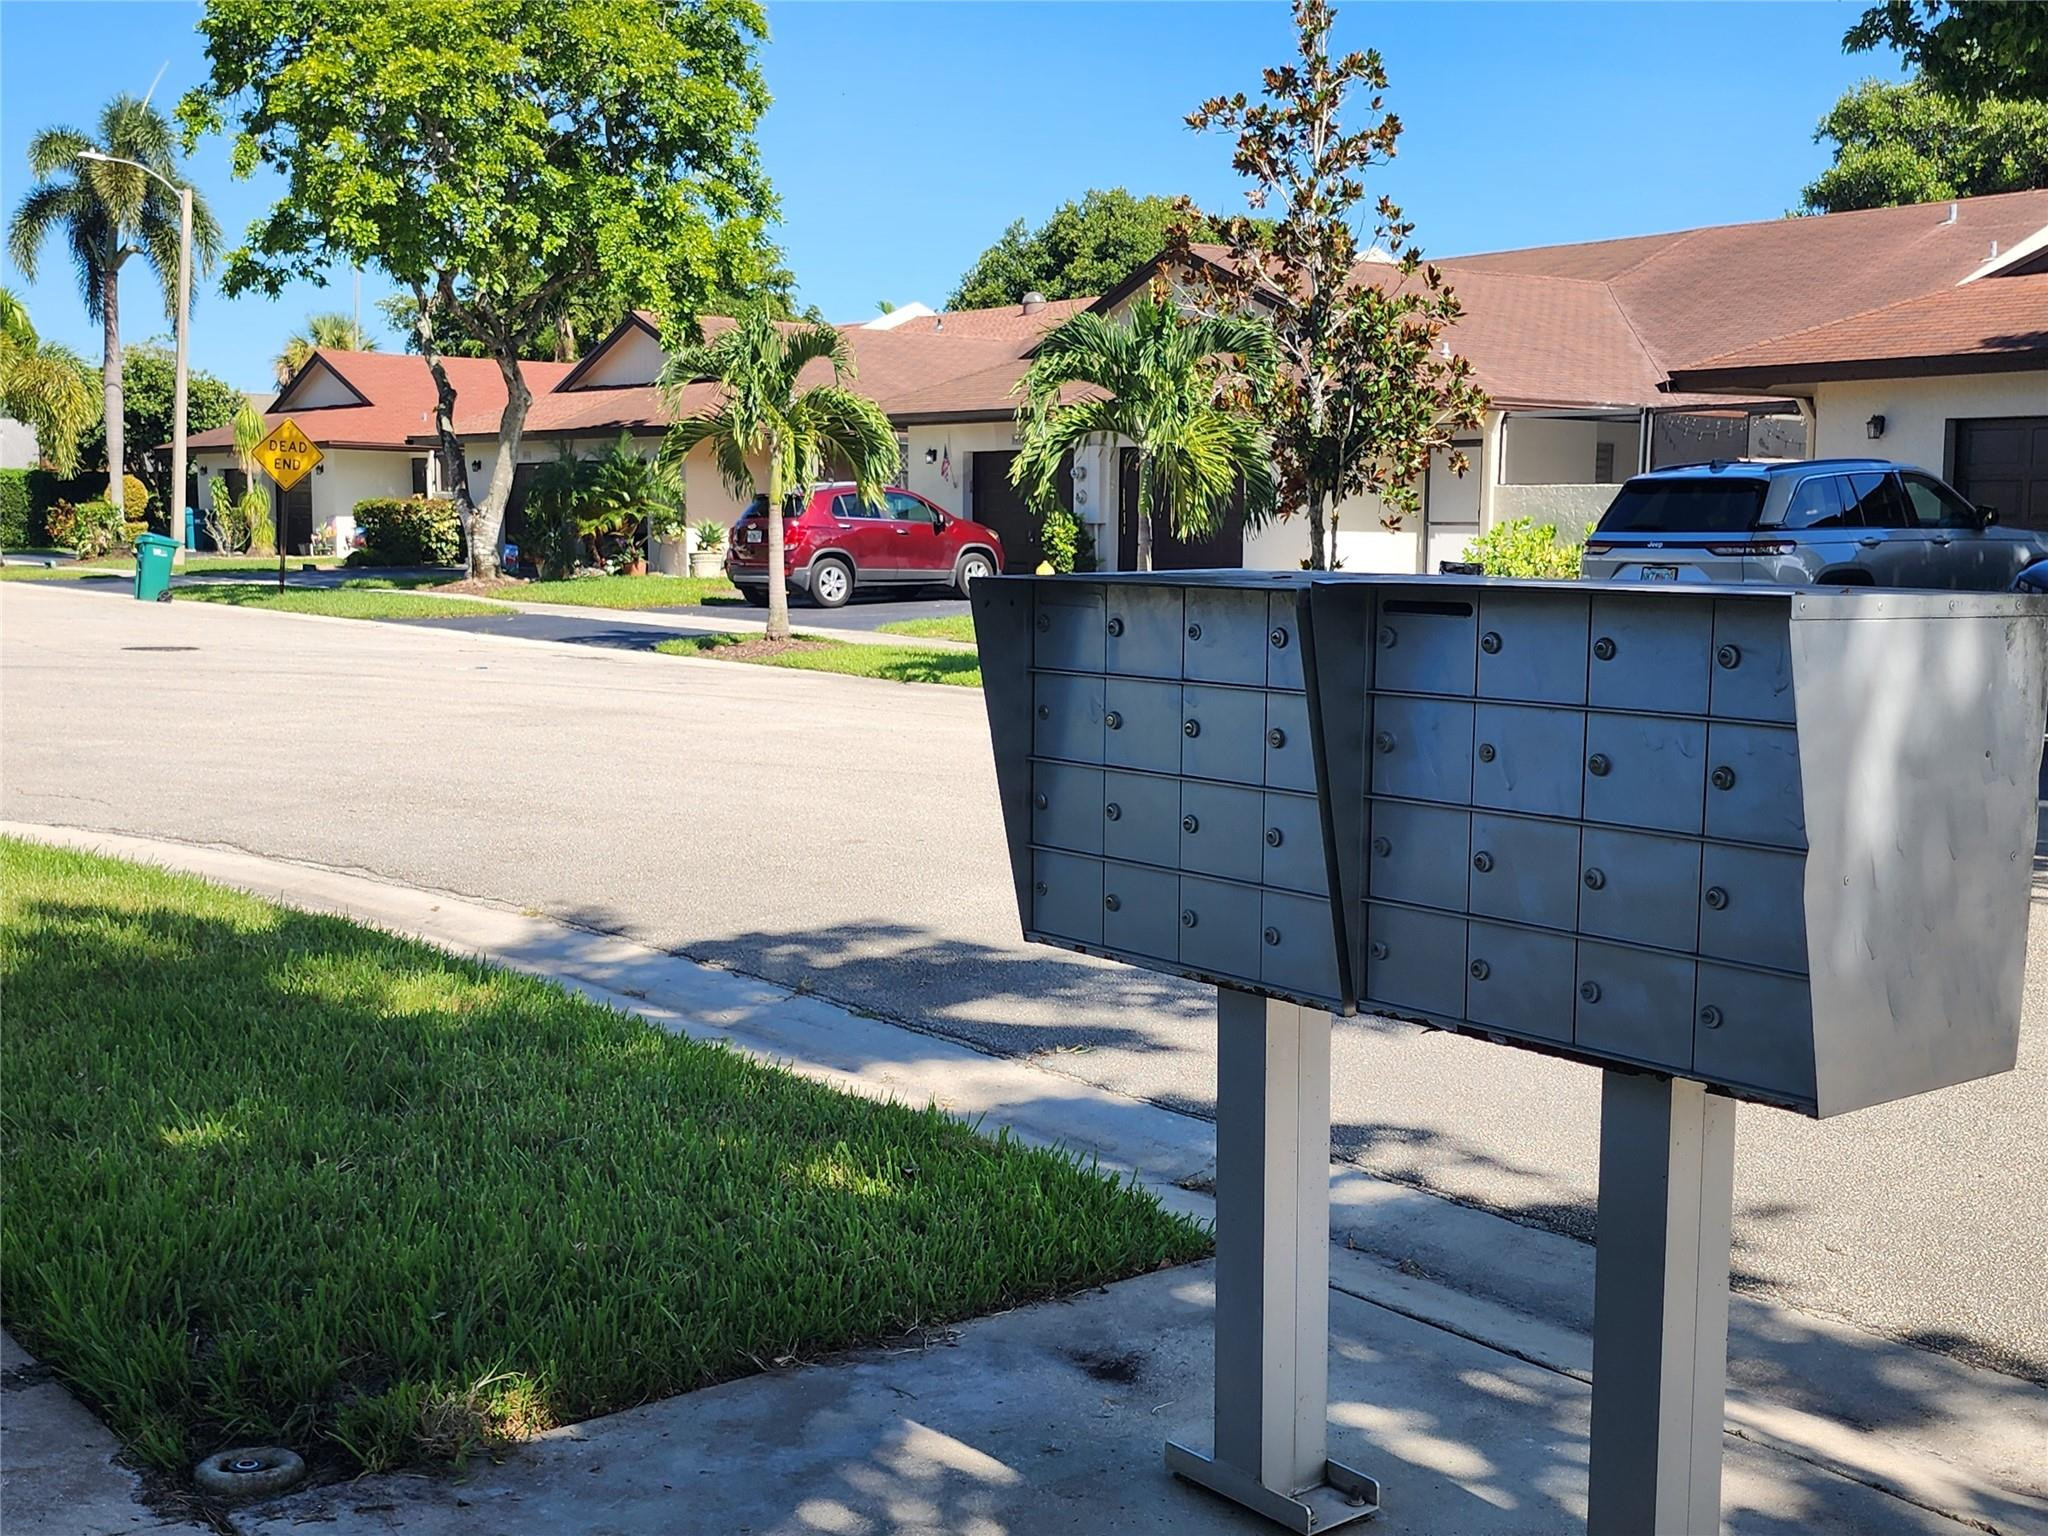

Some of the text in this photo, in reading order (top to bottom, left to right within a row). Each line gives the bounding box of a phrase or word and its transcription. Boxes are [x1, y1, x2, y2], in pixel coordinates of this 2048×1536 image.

[269, 439, 307, 453] DEAD
[274, 457, 301, 470] END
[1647, 541, 1663, 549] Jeep
